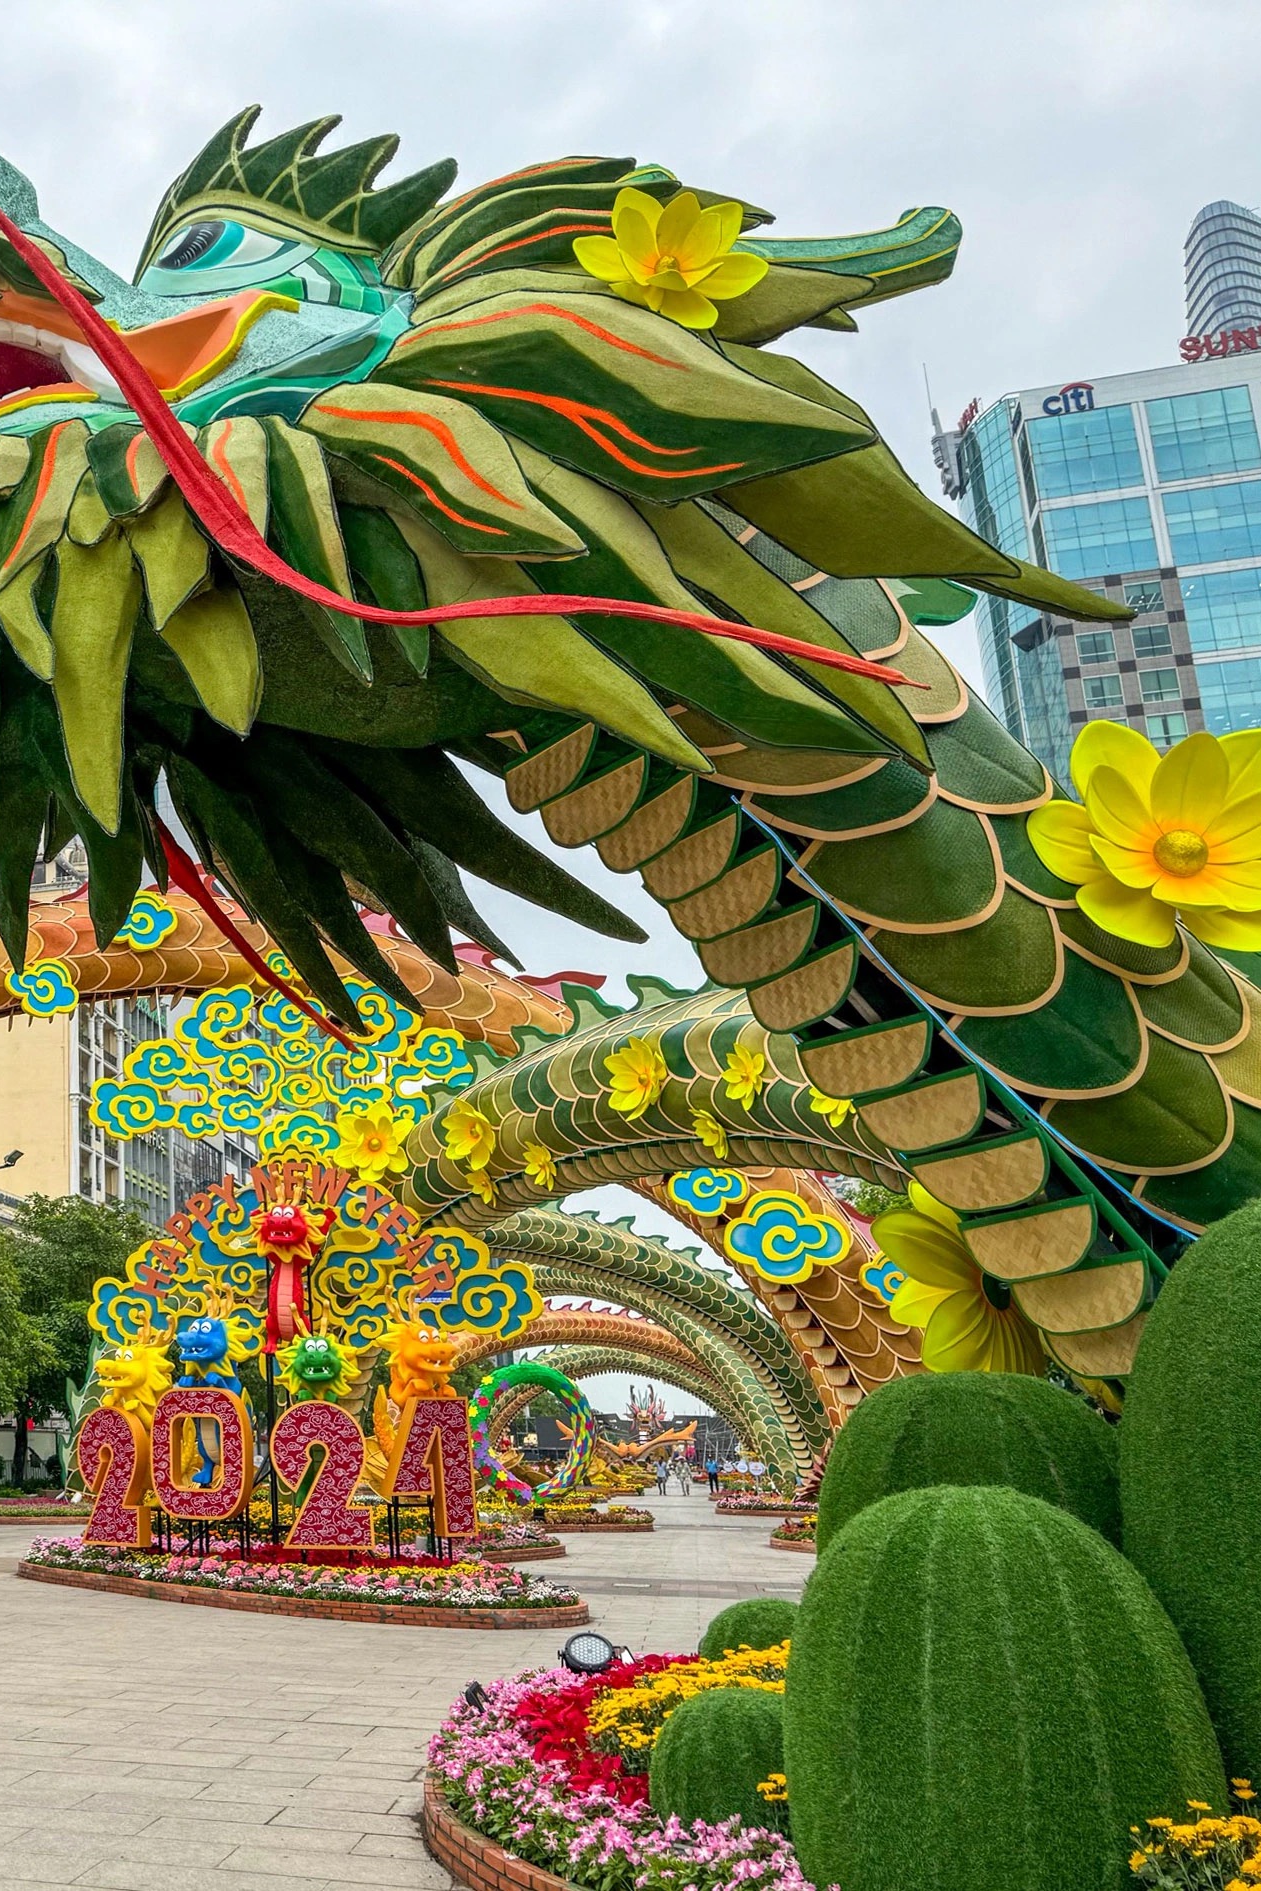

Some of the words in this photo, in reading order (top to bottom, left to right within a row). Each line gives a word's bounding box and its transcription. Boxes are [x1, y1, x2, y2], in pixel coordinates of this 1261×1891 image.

[1179, 325, 1261, 361] SUN
[133, 1173, 238, 1299] HAPPY
[251, 1163, 351, 1208] NEW
[360, 1185, 454, 1298] YEAR
[77, 1387, 478, 1550] 2024
